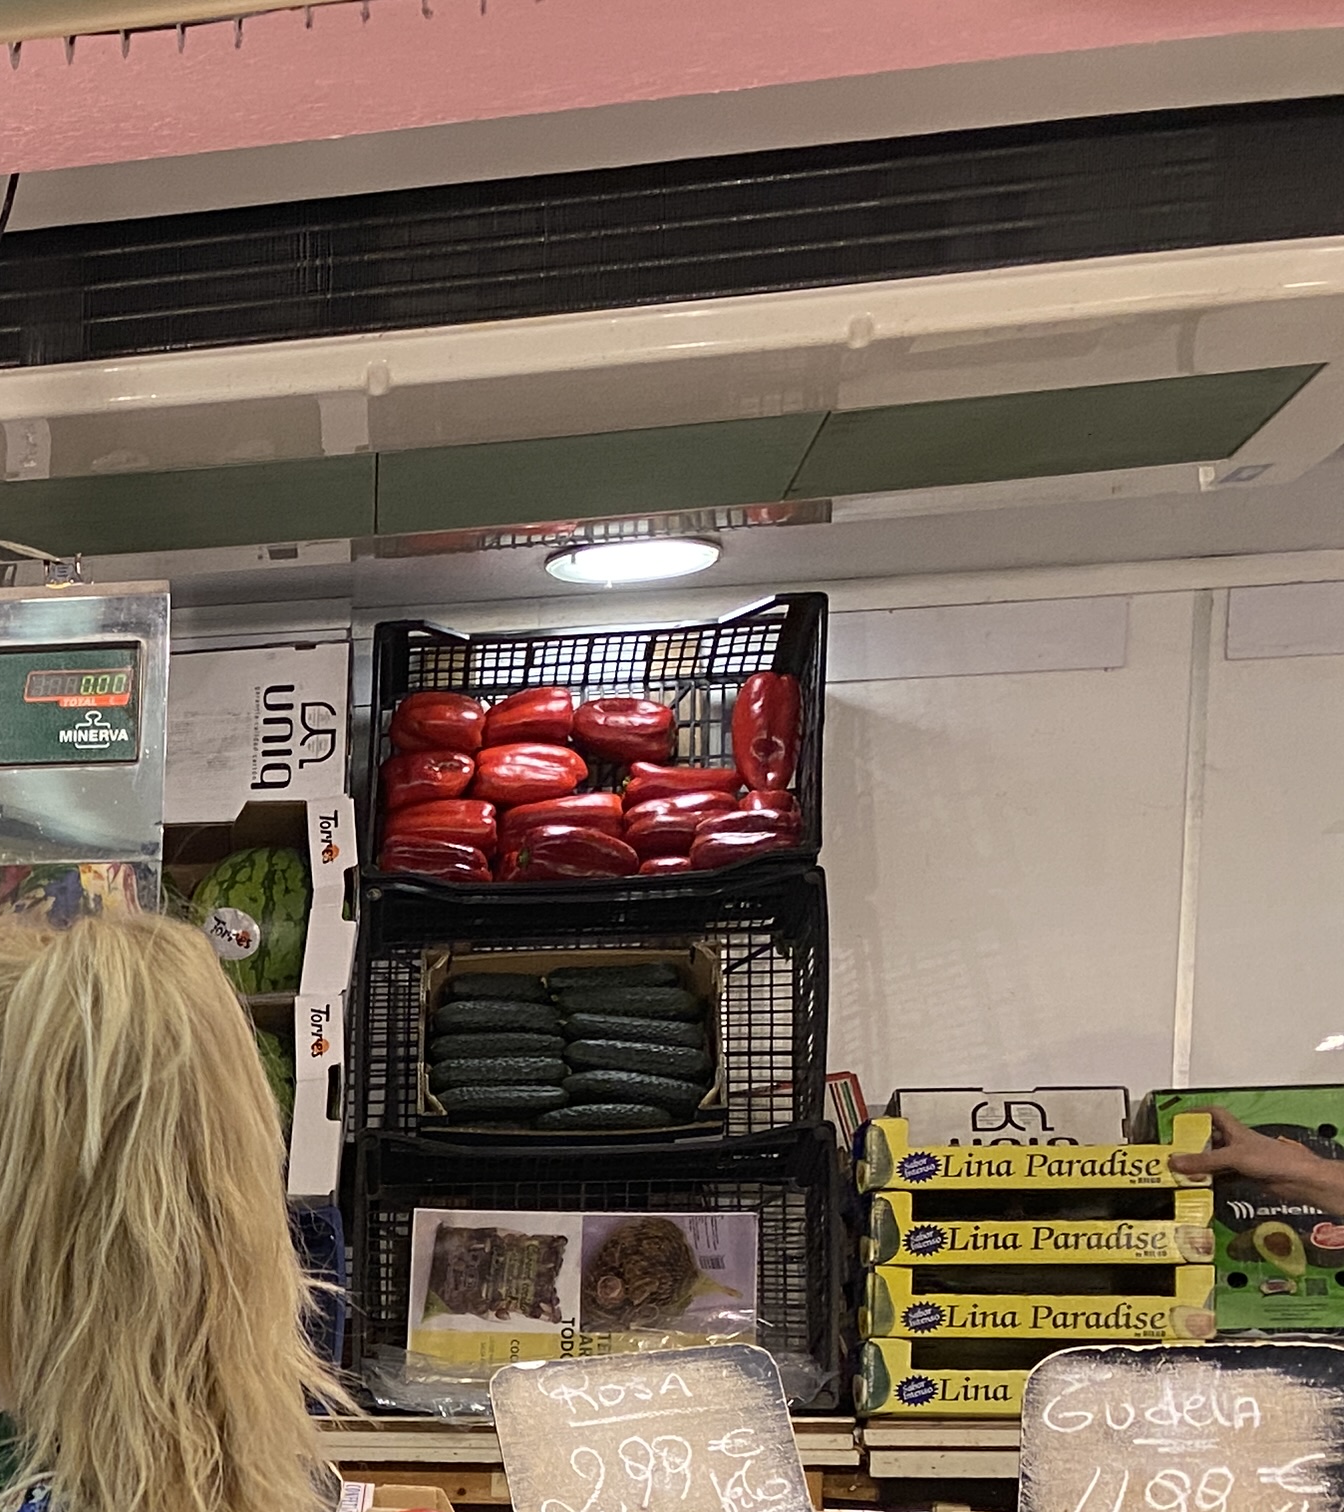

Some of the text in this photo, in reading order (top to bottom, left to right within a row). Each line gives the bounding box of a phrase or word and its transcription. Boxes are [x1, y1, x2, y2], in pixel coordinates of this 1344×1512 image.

[61, 697, 98, 707] TOTAL
[59, 729, 129, 743] MINERVA
[250, 684, 295, 790] uniq
[319, 810, 339, 864] Torres
[311, 1004, 330, 1058] Torres
[941, 1150, 1162, 1178] Lina Paradise
[948, 1223, 1167, 1251] Lina Paradise
[945, 1302, 1168, 1330] Lina Paradise
[938, 1376, 1012, 1402] Lina
[707, 1429, 764, 1457] €
[1257, 1453, 1330, 1493] €
